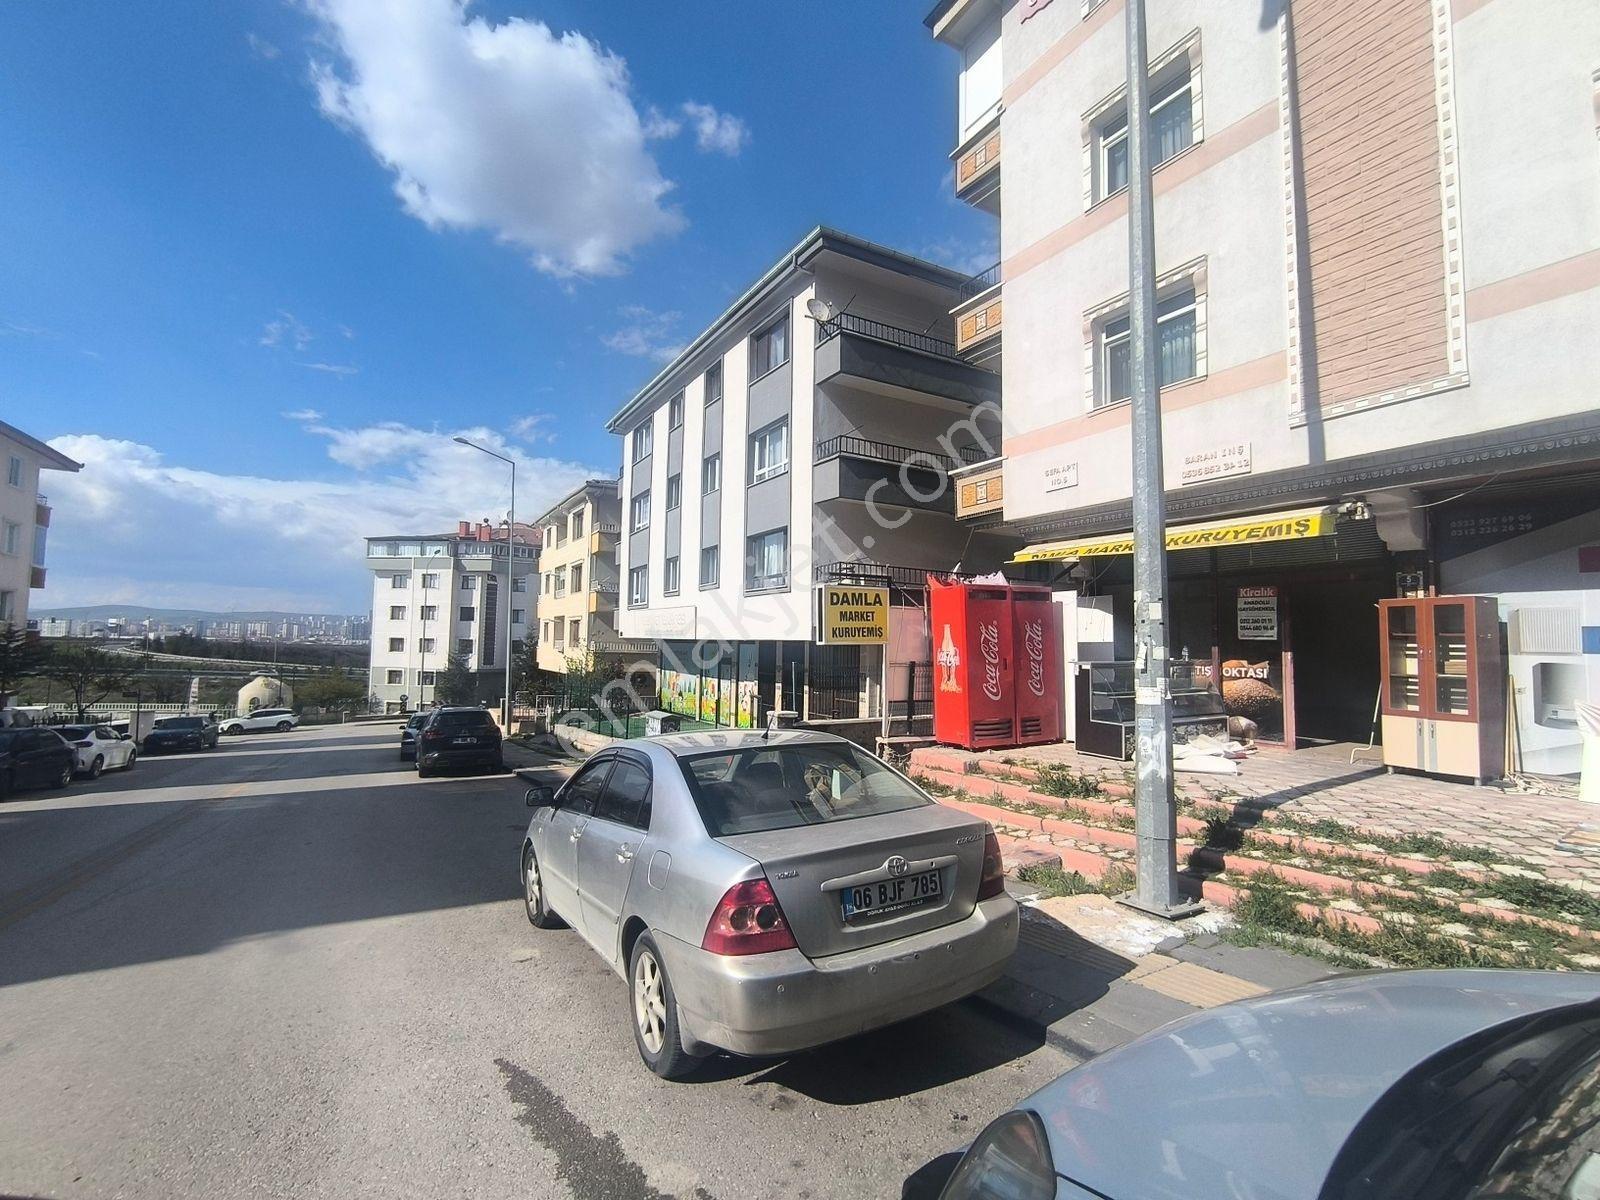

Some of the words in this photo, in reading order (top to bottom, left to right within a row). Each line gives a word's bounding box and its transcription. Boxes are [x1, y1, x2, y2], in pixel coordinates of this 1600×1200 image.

[1083, 543, 1134, 555] MARK
[829, 592, 883, 607] DAMLA
[839, 610, 876, 622] MARKET
[831, 625, 884, 639] KURUYEMİŞ
[1195, 665, 1213, 677] TIŞ
[1222, 666, 1268, 679] OKTASI
[853, 887, 873, 910] 06
[878, 880, 906, 904] BJF
[910, 873, 939, 898] 785
